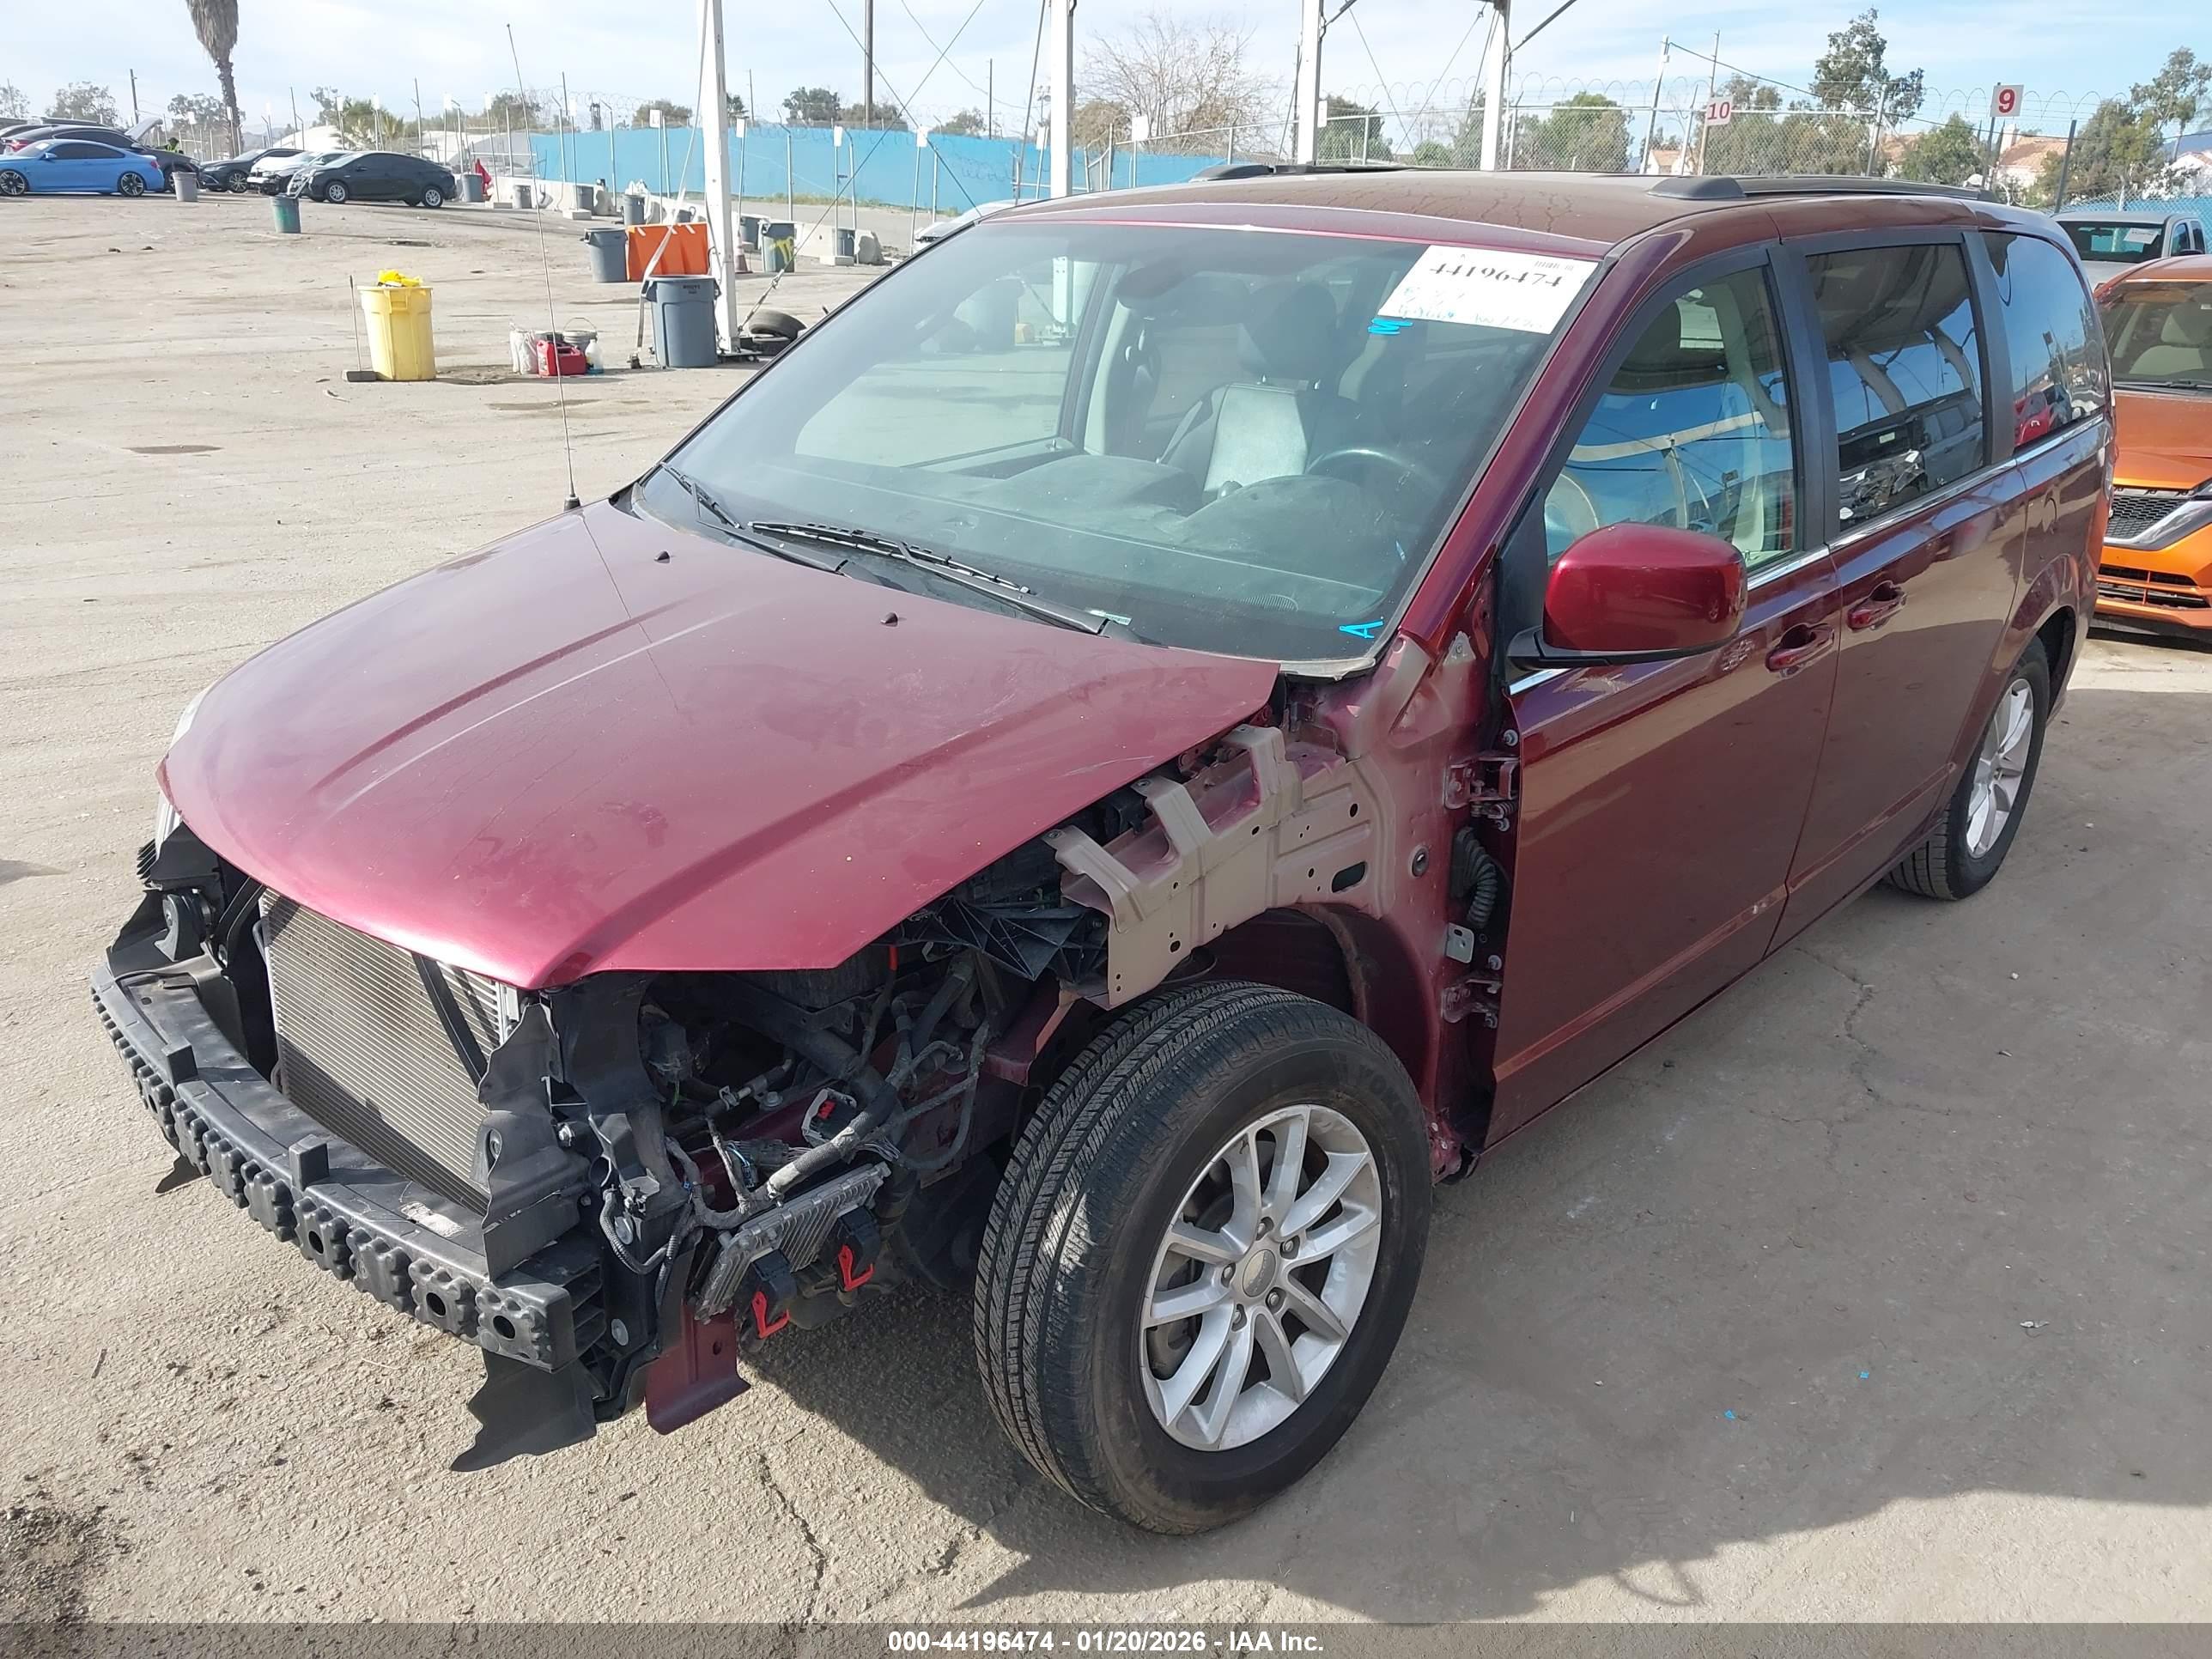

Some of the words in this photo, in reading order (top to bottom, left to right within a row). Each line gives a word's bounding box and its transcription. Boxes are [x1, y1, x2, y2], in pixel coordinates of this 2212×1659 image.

[1707, 101, 1730, 120] 10
[1998, 88, 2016, 113] 9
[1430, 263, 1563, 288] 44196474
